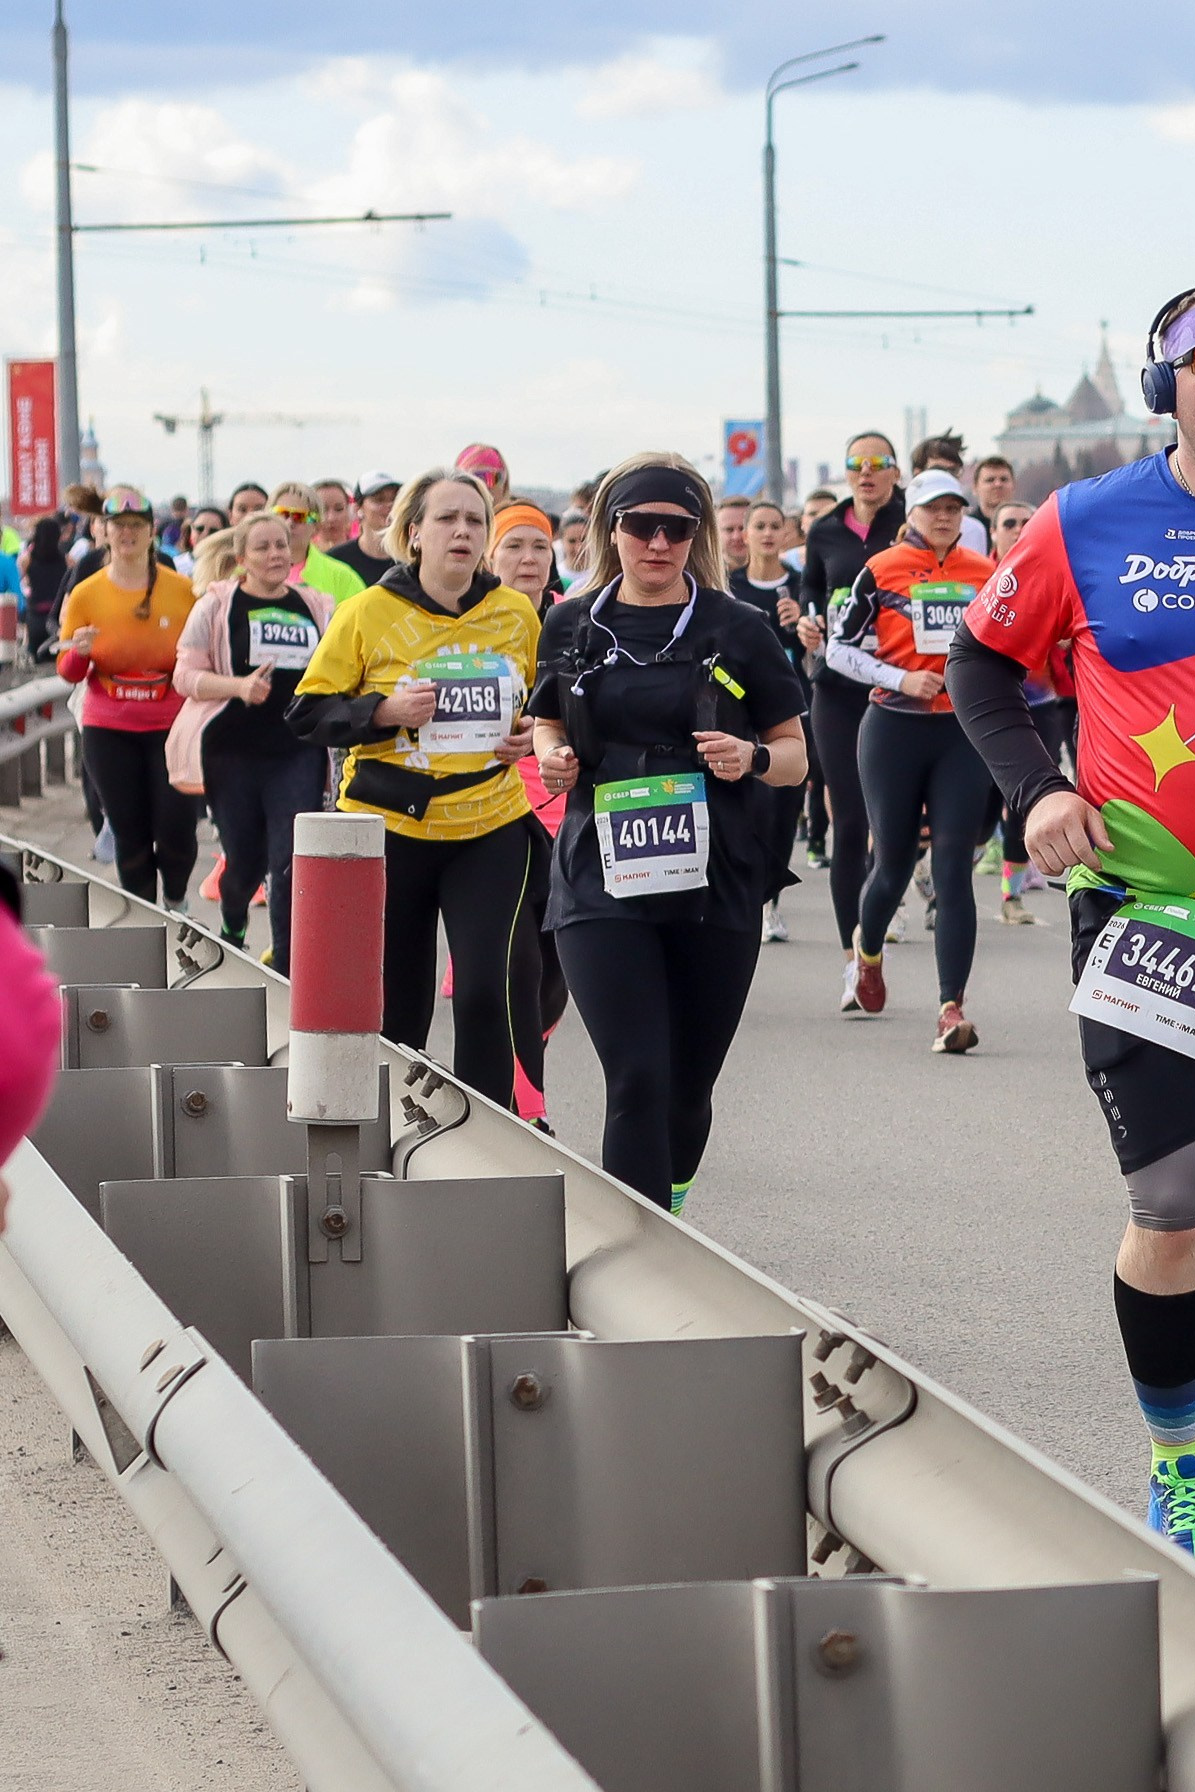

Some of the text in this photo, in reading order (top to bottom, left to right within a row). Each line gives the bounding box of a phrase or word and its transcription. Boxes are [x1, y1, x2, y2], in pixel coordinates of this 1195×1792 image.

[727, 430, 757, 467] 9
[264, 623, 305, 643] 39421
[437, 685, 496, 713] 42158
[619, 814, 691, 848] 40144
[1143, 904, 1165, 912] СБЕР
[1108, 920, 1126, 930] 2026
[1135, 973, 1182, 999] ЕВГЕНИЙ
[1102, 994, 1141, 1013] МАГНИТ
